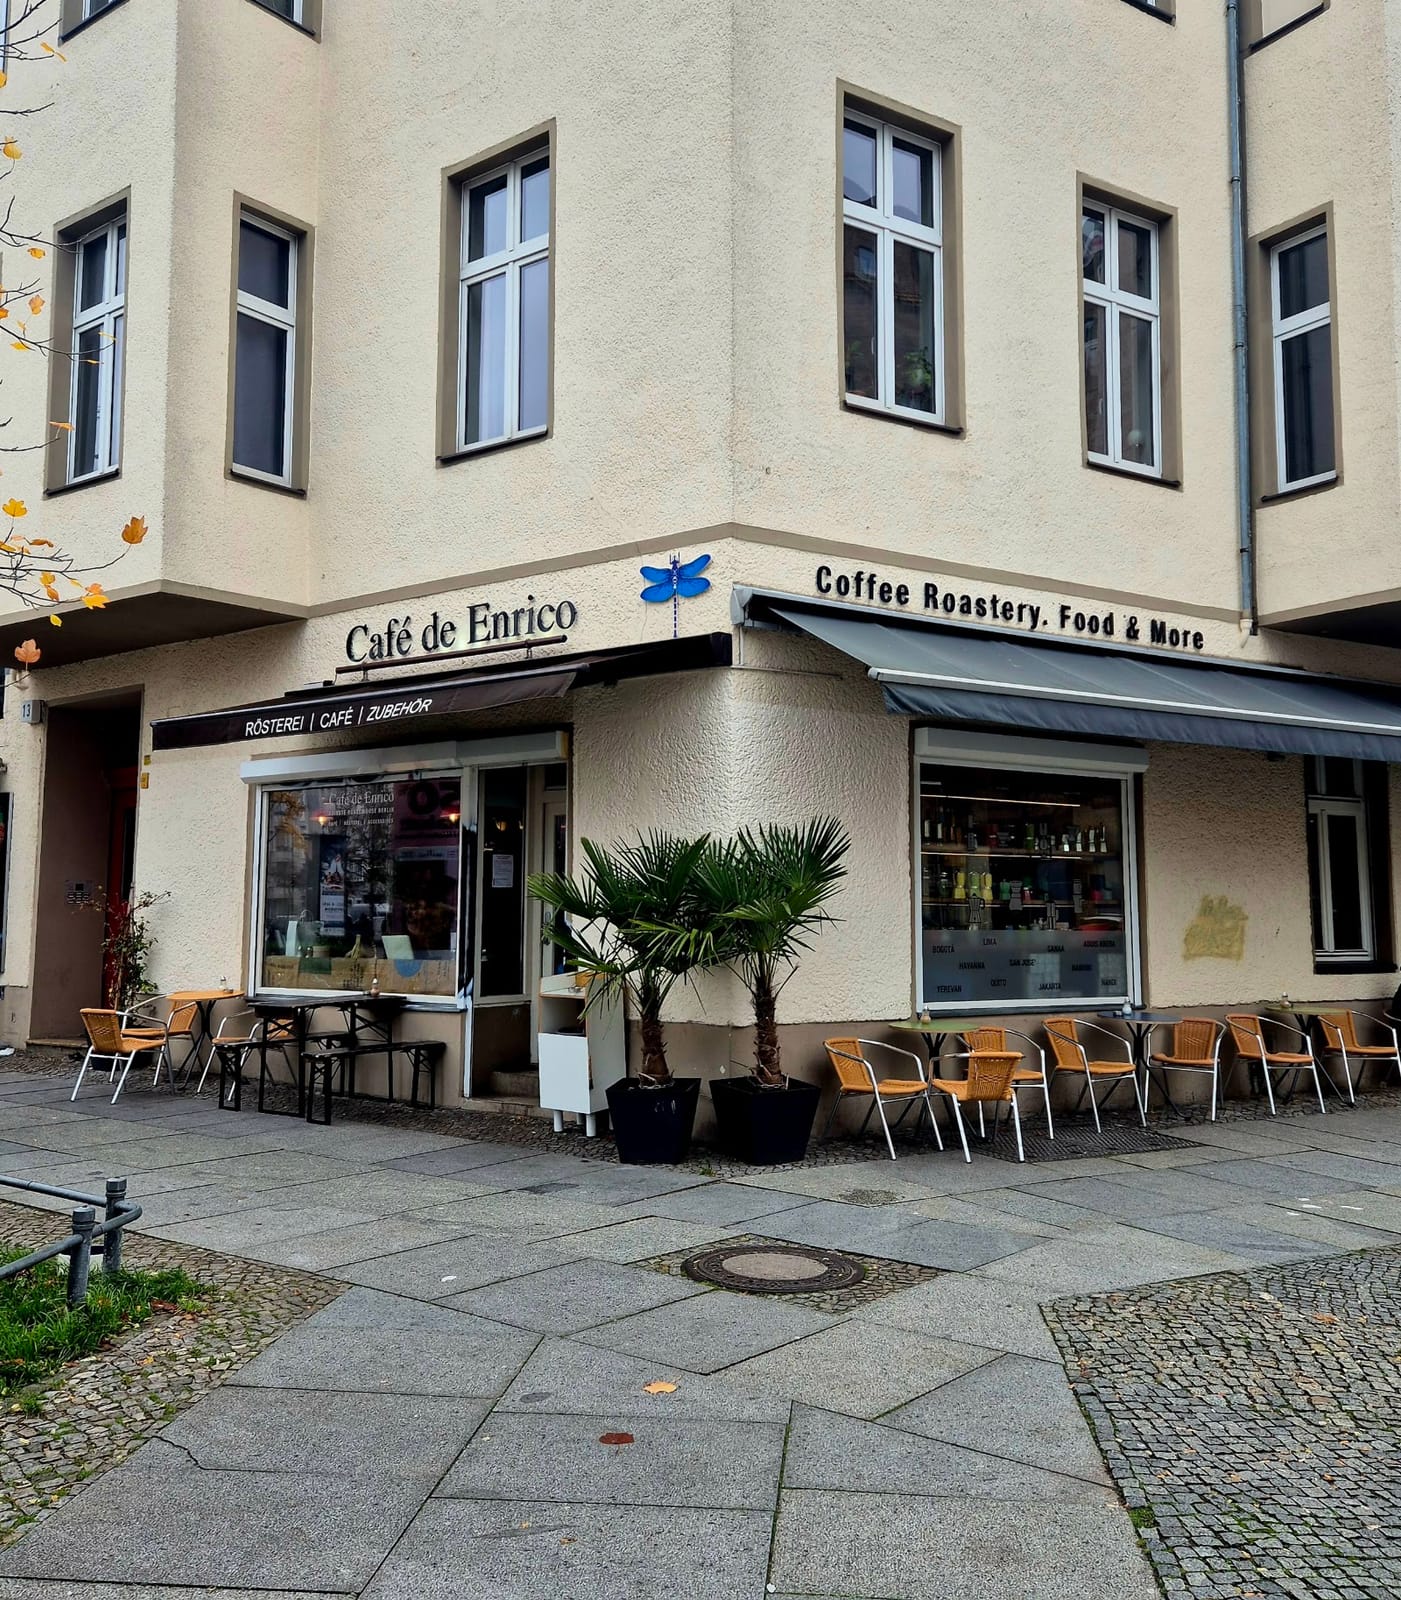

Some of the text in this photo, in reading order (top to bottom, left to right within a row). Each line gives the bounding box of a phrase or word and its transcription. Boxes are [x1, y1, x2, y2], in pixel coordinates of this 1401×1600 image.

[816, 566, 909, 605] Coffee
[1060, 605, 1114, 635] Food
[1126, 616, 1140, 640] &
[1151, 619, 1204, 649] More
[346, 595, 577, 662] Café de Enrico
[22, 704, 31, 718] 13
[245, 716, 304, 736] RÖSTEREI
[320, 706, 353, 728] CAFÉ
[366, 698, 432, 721] ZUBEHÖR
[329, 790, 394, 805] Café de Enrico
[983, 938, 997, 946] LIMA
